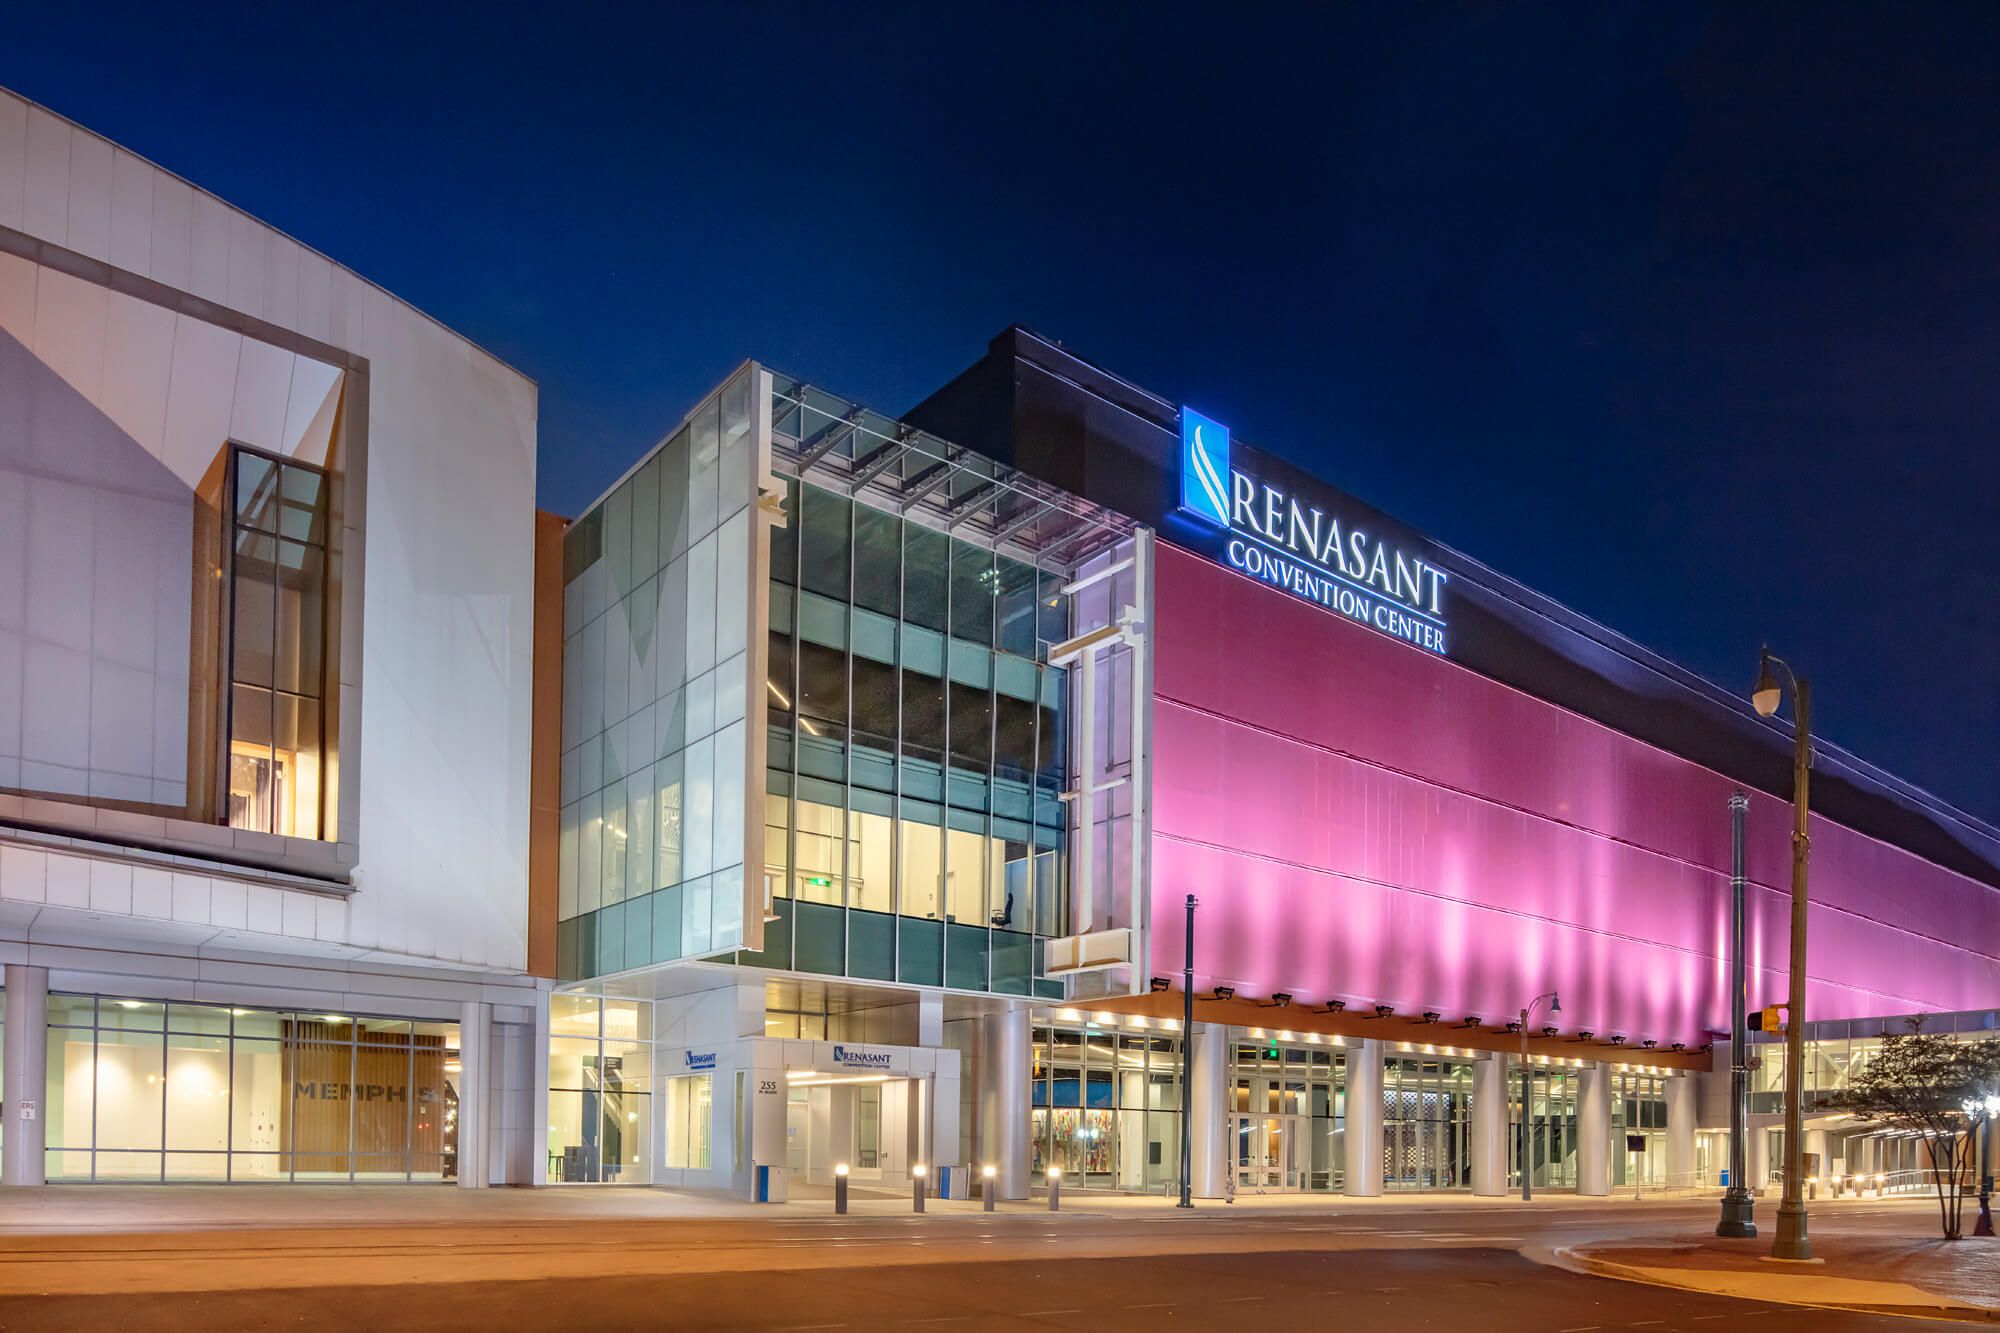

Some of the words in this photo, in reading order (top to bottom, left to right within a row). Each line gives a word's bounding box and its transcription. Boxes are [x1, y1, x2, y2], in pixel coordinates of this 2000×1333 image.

[1231, 469, 1447, 614] RENASANT
[1229, 540, 1369, 625] CONVENTION
[1375, 605, 1446, 653] CENTER
[690, 1053, 716, 1064] RENASANT
[843, 1052, 891, 1063] RENASANT
[296, 1082, 435, 1102] MEMPHS
[760, 1080, 776, 1090] 255
